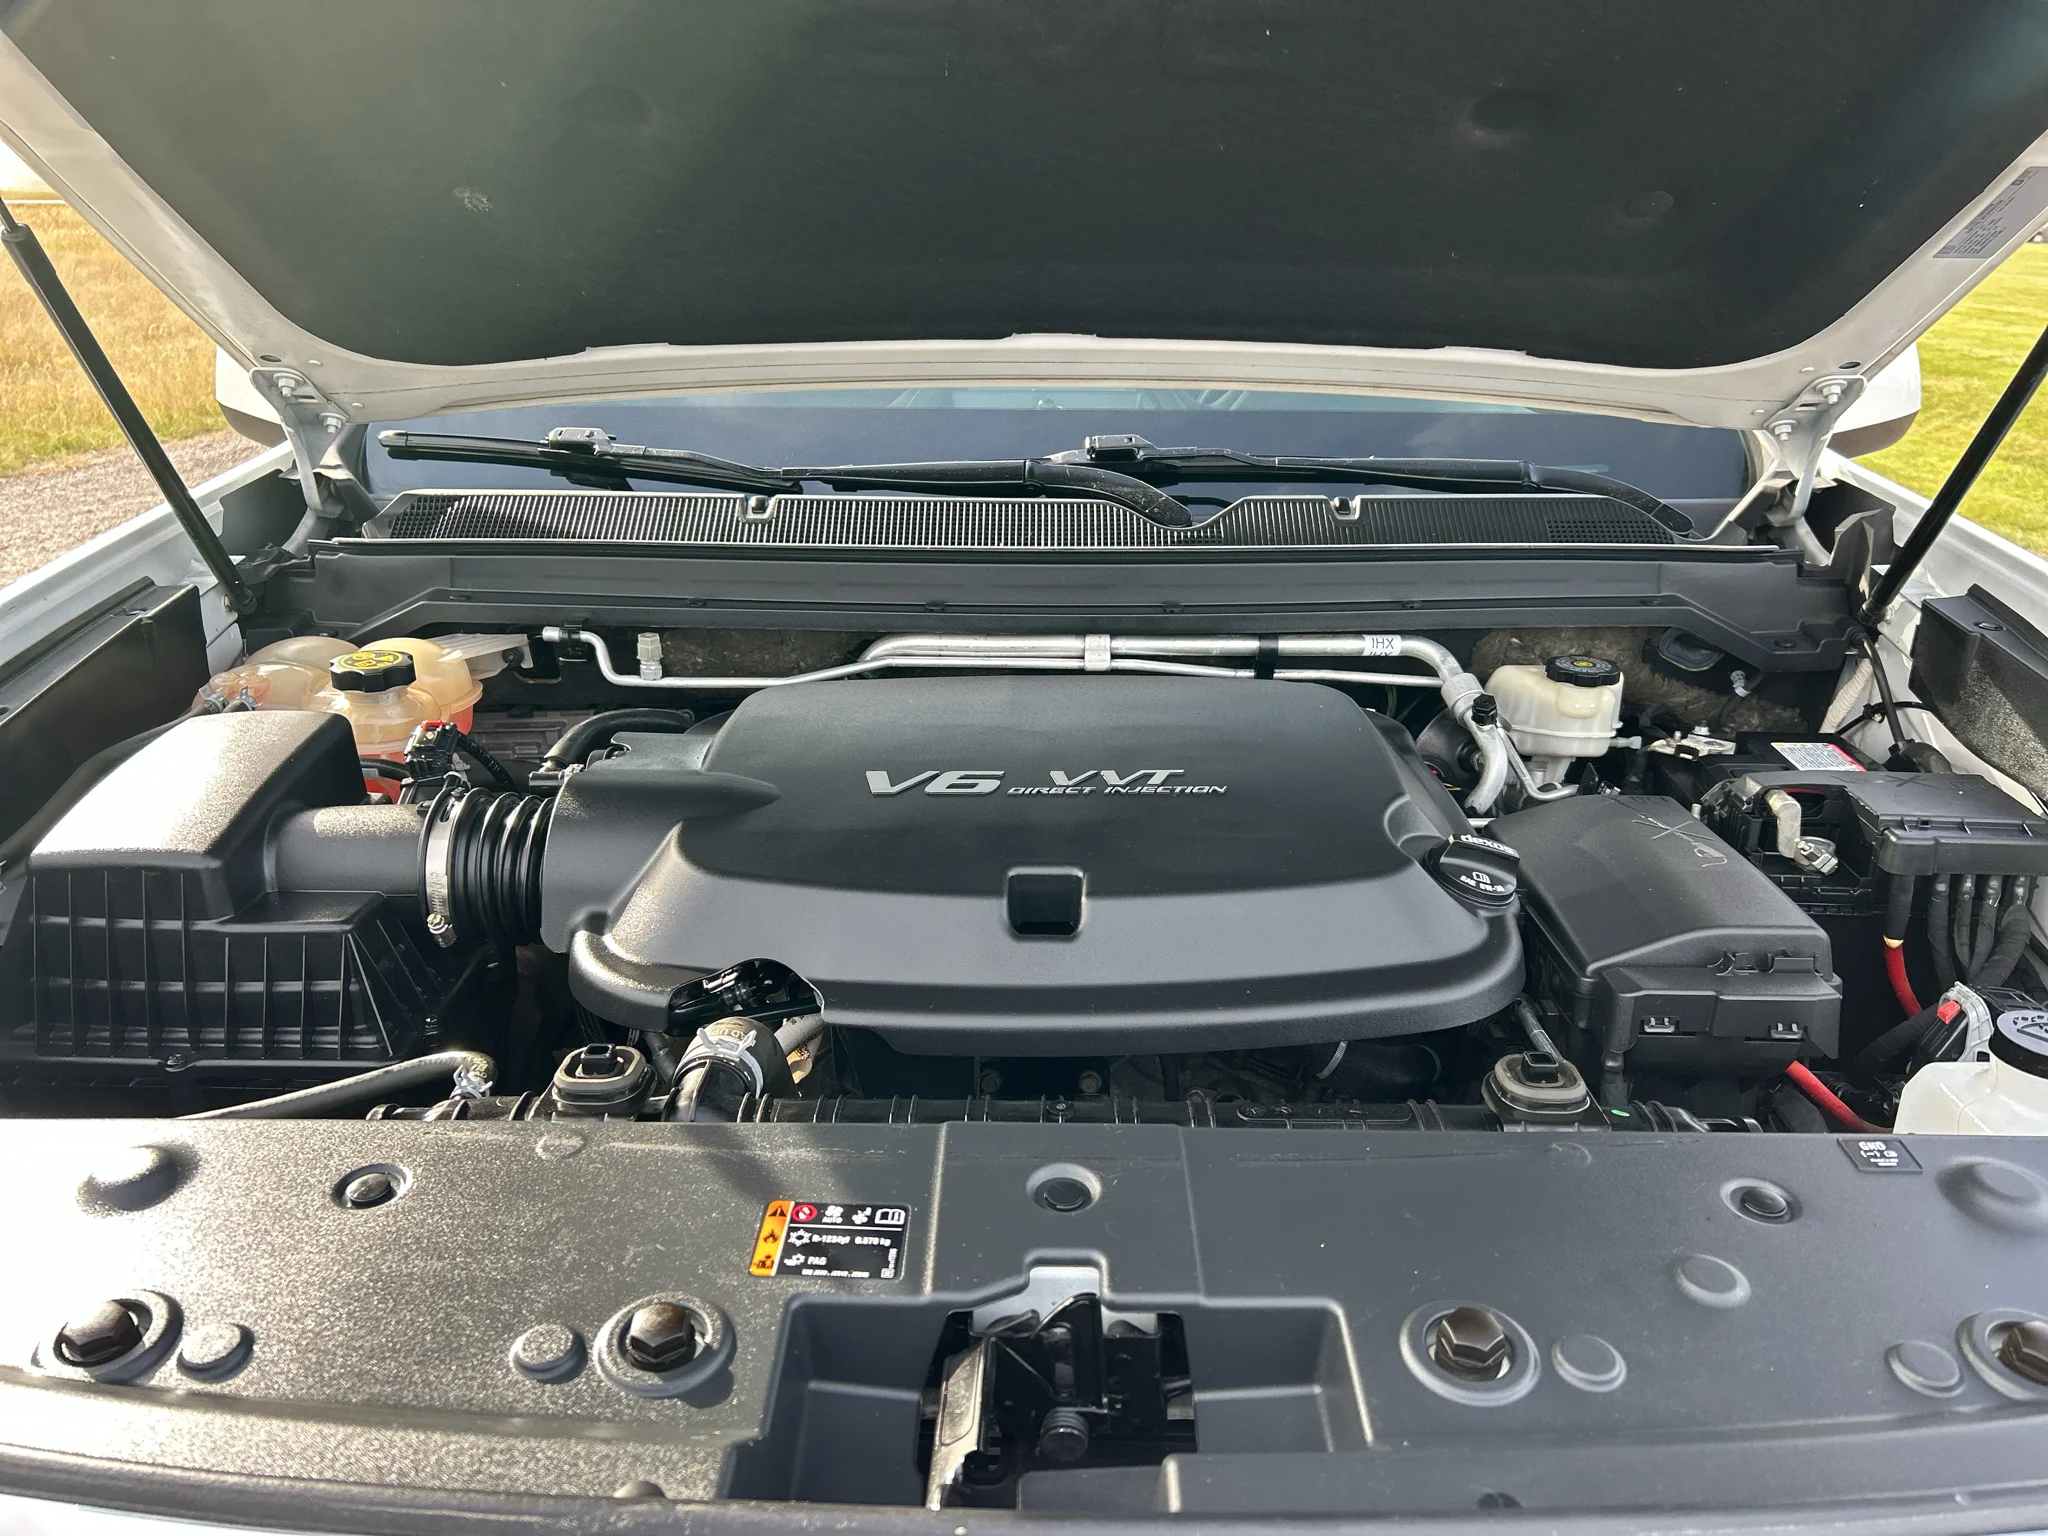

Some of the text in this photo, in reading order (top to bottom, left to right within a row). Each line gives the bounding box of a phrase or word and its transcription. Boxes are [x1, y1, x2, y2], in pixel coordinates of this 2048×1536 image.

[865, 769, 1185, 796] V6 VVT
[1006, 785, 1229, 796] DIRECT INJECTION
[1460, 834, 1515, 855] dexos
[1459, 875, 1477, 887] SAE
[807, 1256, 828, 1266] PAG
